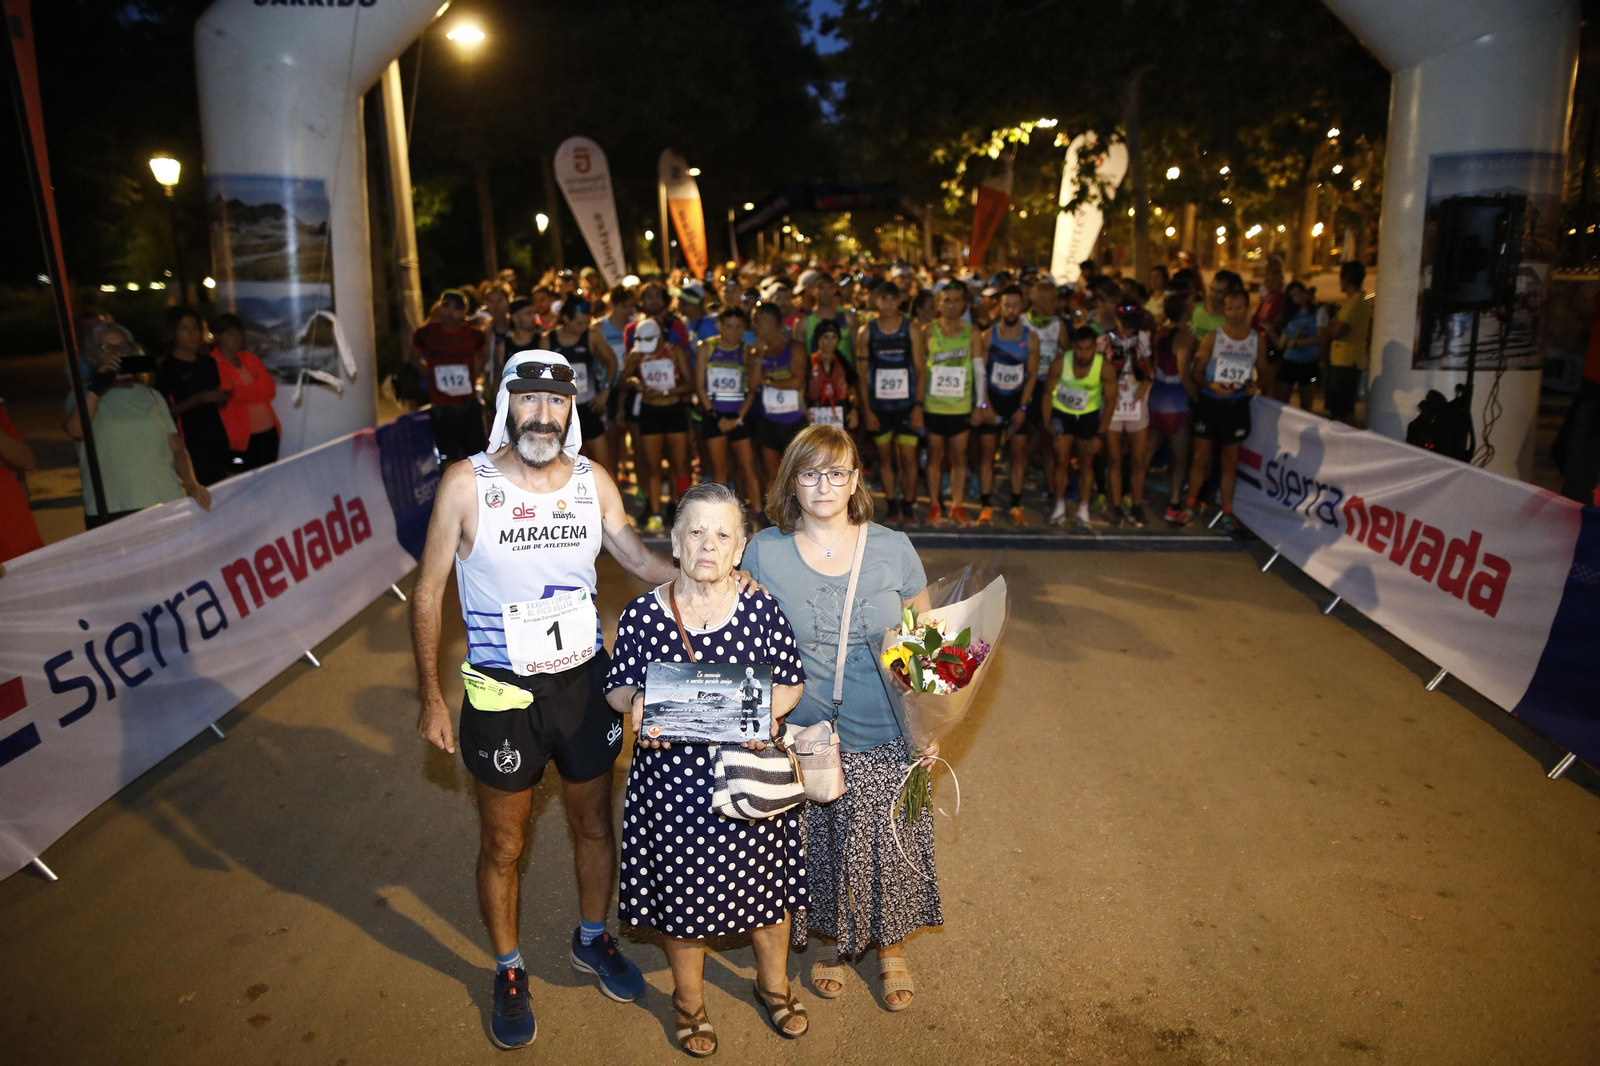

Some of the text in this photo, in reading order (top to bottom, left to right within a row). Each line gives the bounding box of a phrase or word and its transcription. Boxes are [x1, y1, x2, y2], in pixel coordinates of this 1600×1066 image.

[442, 374, 465, 386] 112
[647, 371, 668, 382] 401
[997, 372, 1019, 383] 106
[1220, 368, 1244, 380] 437
[712, 378, 736, 390] 450
[881, 378, 903, 390] 297
[937, 376, 960, 388] 253
[776, 392, 785, 404] 6
[512, 502, 536, 520] als
[499, 525, 588, 545] MARACENA
[1264, 454, 1512, 618] sierra nevada
[512, 544, 531, 552] CLUB
[525, 593, 572, 610] XXXVIII SUBIDA
[43, 494, 372, 728] sierra nevada
[527, 600, 573, 617] AL PICO VELETA
[546, 620, 563, 651] 1
[525, 645, 594, 673] alssport.es
